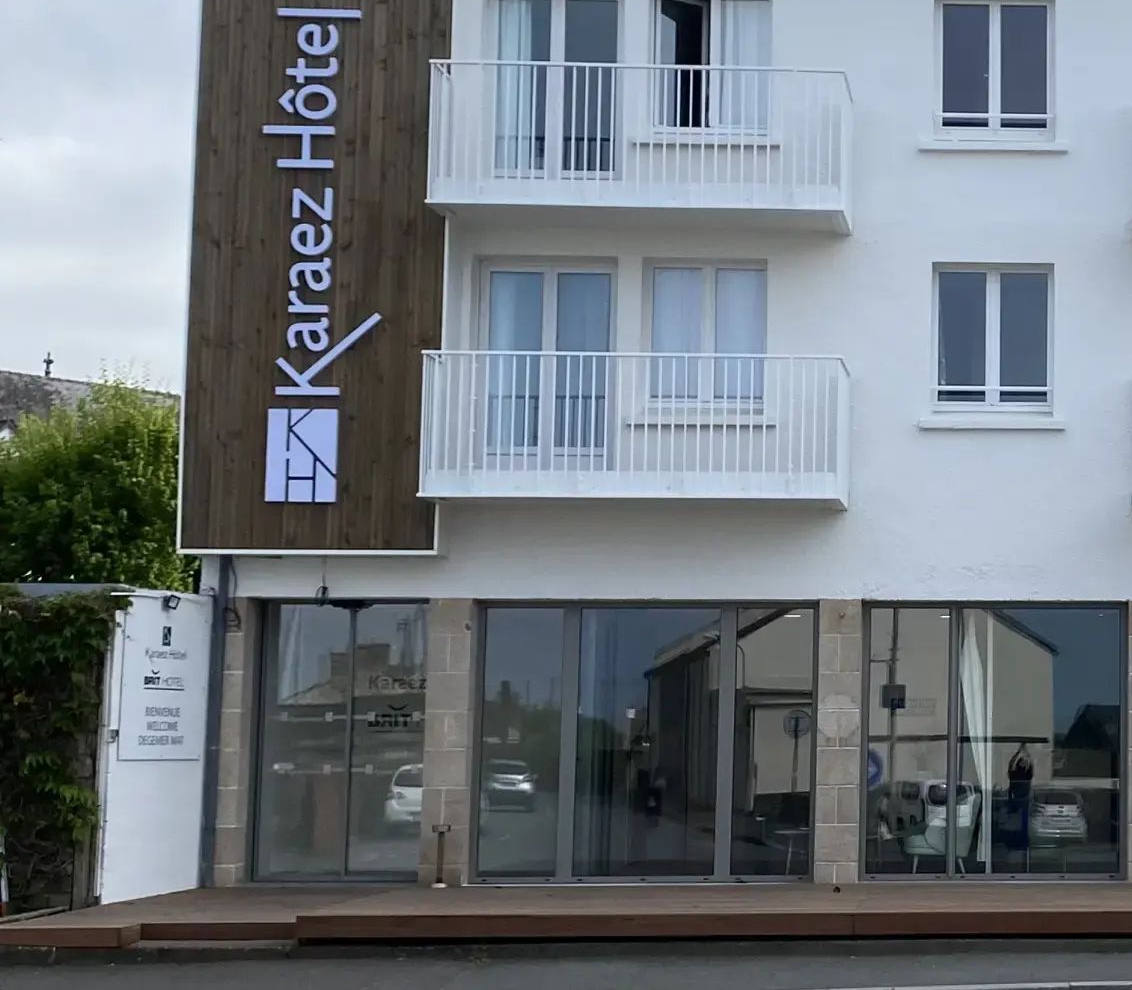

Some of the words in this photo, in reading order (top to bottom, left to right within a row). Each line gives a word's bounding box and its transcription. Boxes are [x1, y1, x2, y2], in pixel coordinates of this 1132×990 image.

[262, 7, 362, 169] Hôtel
[275, 186, 382, 396] Karaez
[144, 675, 161, 686] BRIT
[162, 676, 185, 687] HOTEL
[145, 706, 181, 717] BIENVENUE
[146, 721, 179, 731] WELCOME
